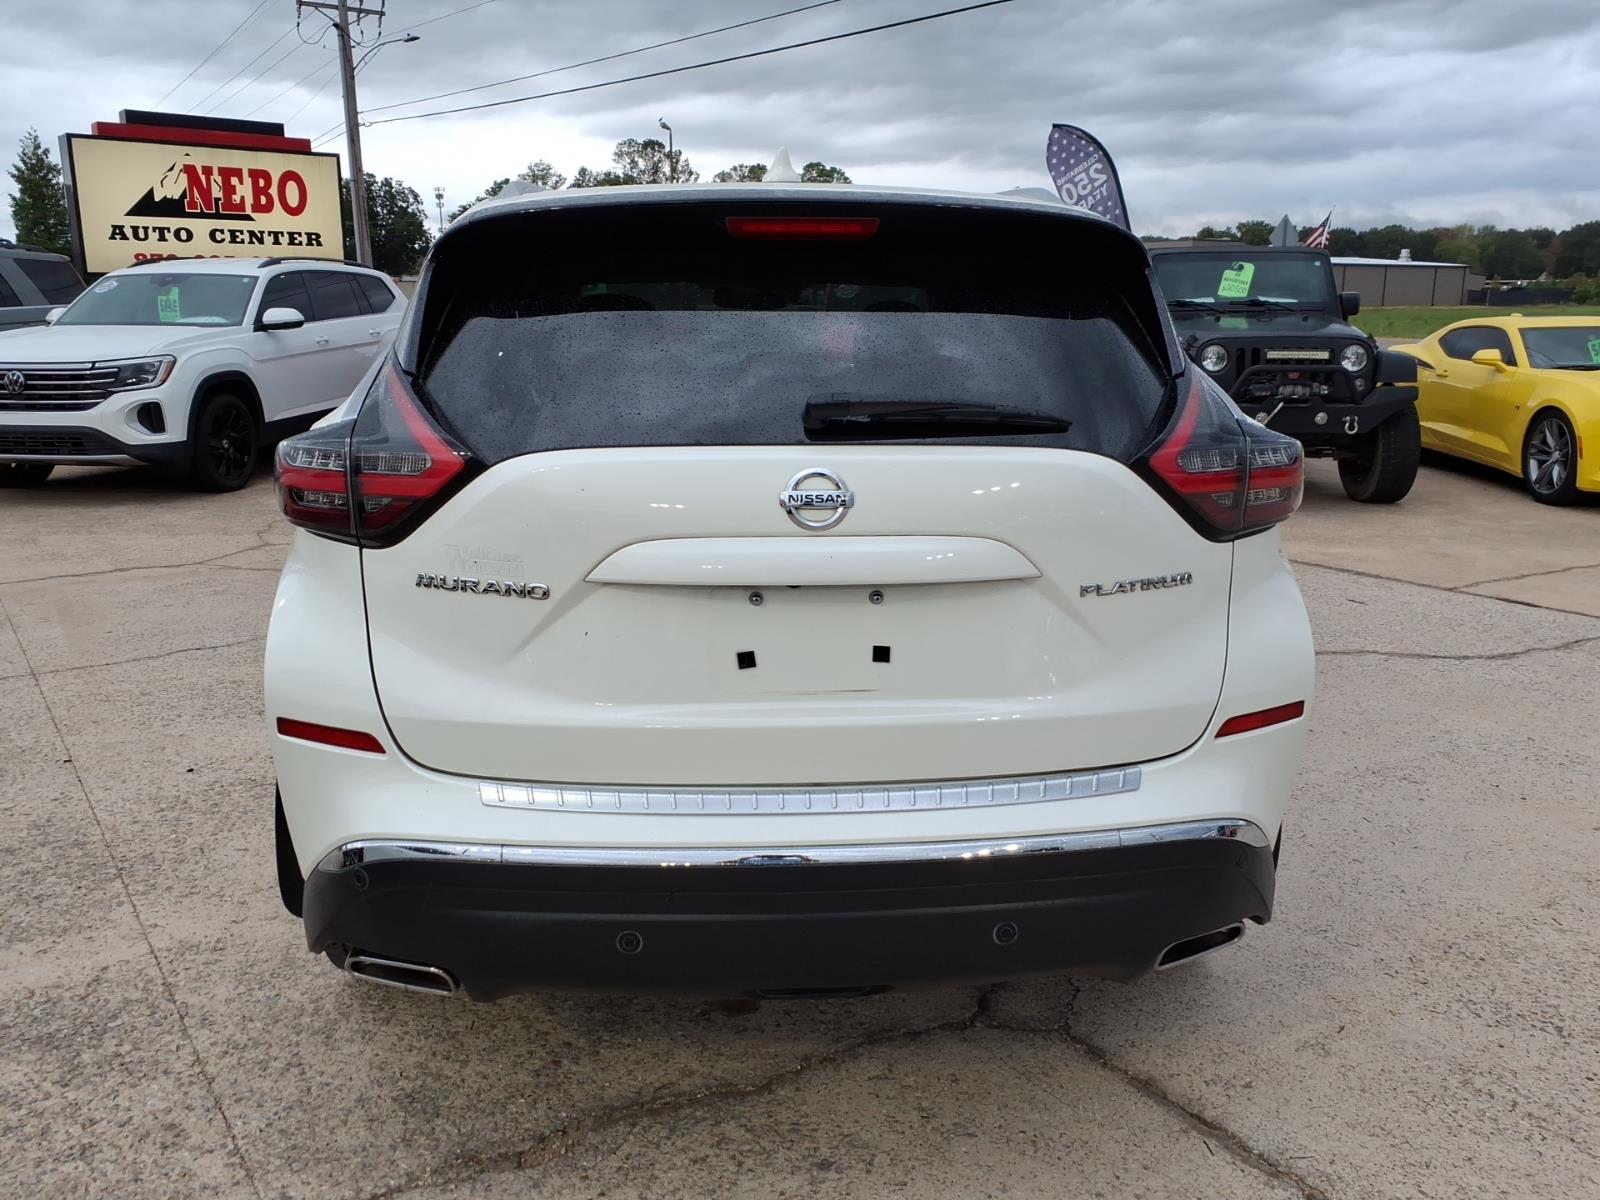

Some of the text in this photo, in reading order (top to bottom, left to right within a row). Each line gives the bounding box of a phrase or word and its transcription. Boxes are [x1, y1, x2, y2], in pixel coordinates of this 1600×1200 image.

[183, 164, 307, 216] NEBO
[108, 224, 323, 247] AUTO CENTER
[788, 494, 847, 506] NISSAN
[416, 572, 550, 600] MURANO
[1080, 571, 1192, 597] PLATINUM
